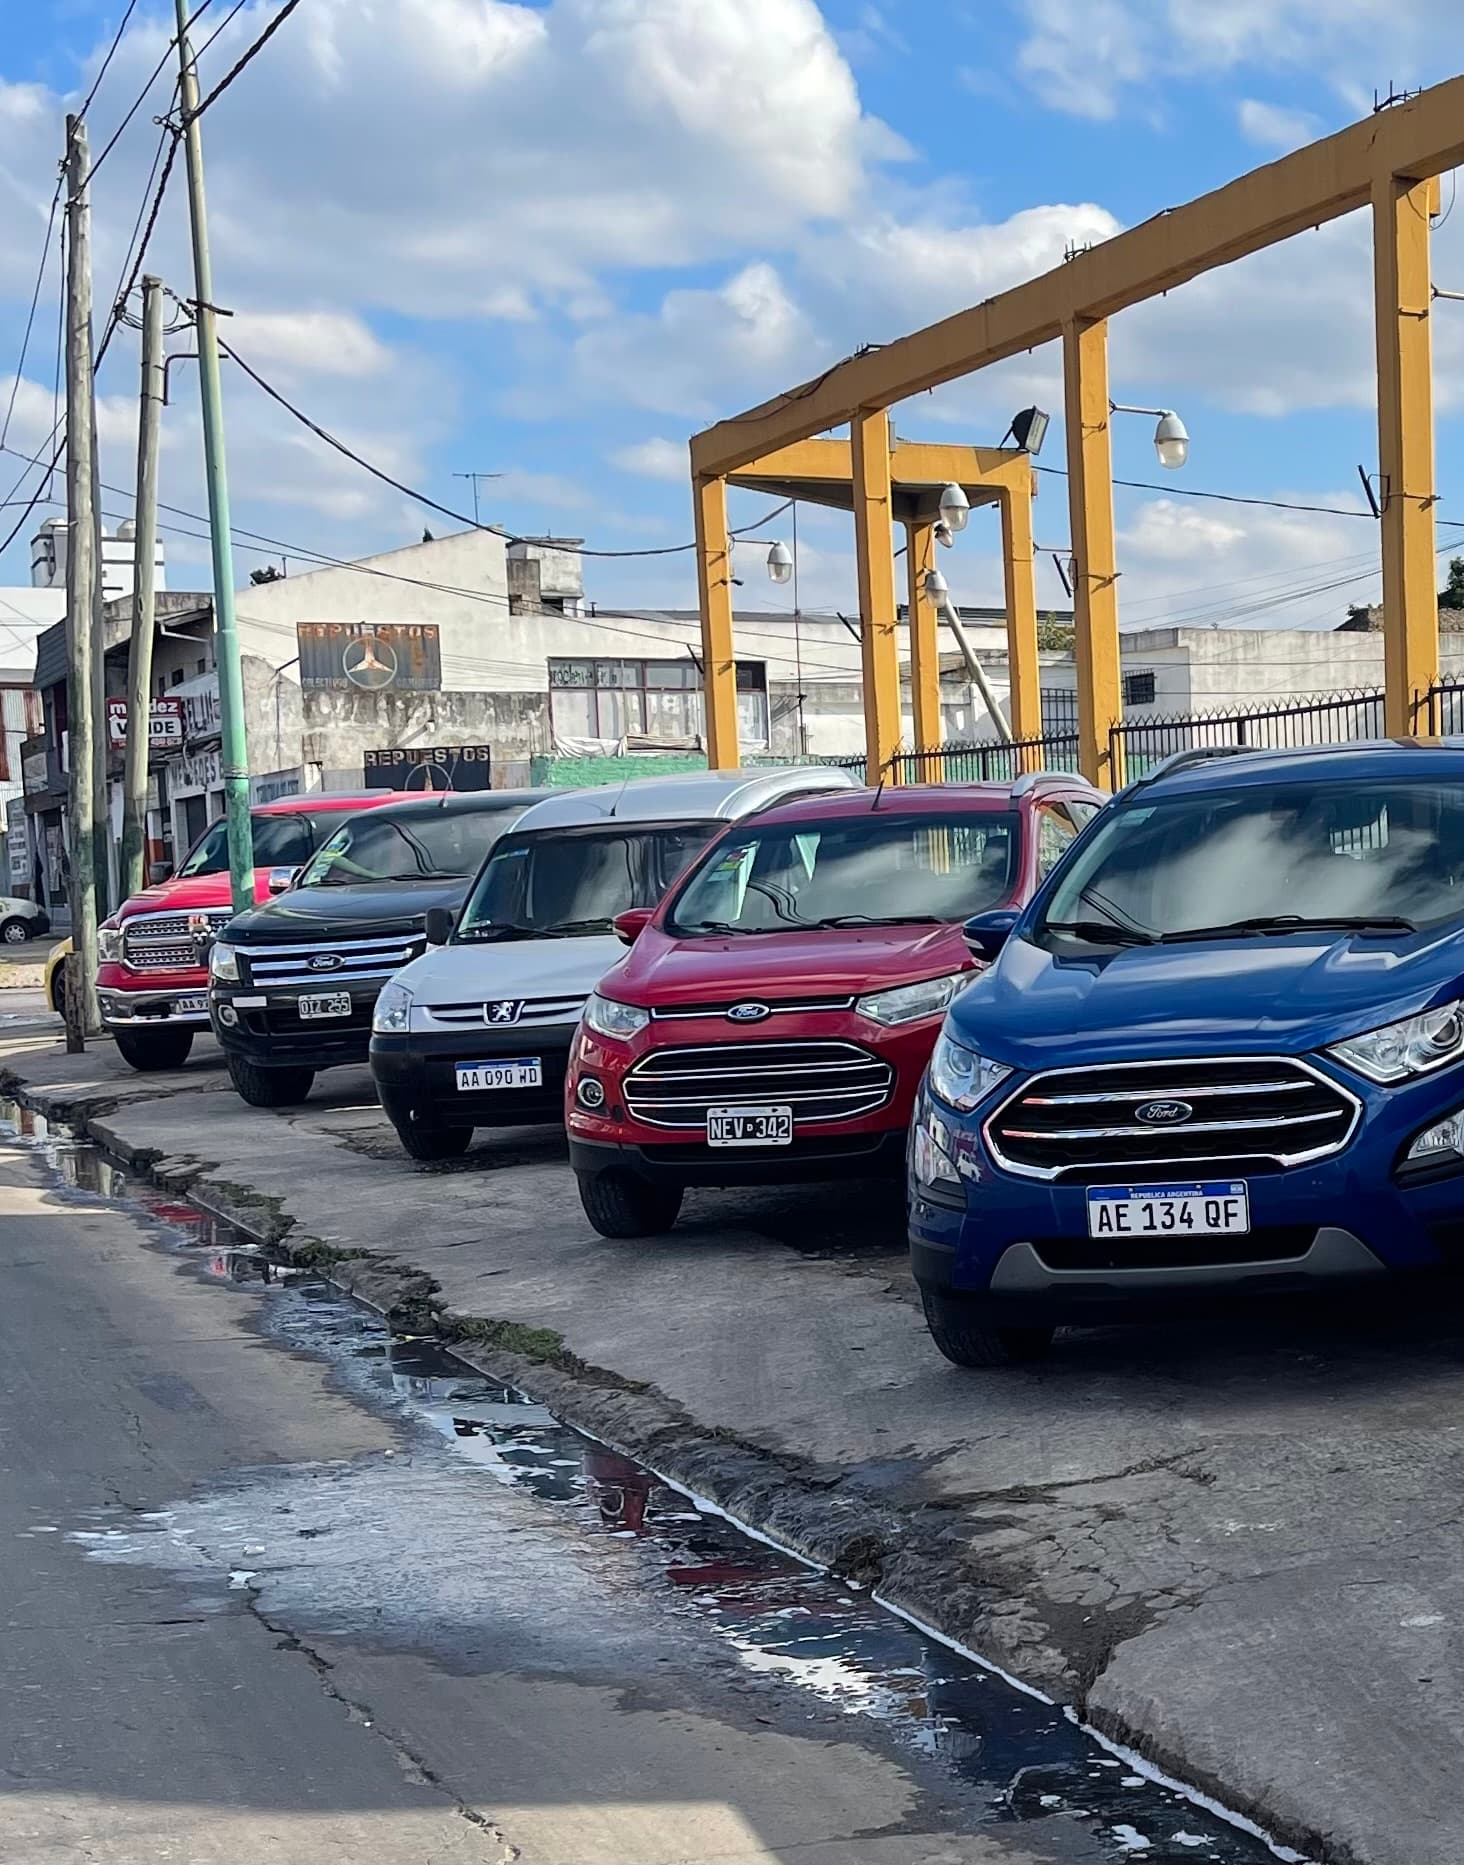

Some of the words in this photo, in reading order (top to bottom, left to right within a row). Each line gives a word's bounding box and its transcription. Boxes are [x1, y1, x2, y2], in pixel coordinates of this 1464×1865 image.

[117, 721, 174, 734] VDE
[365, 748, 489, 767] REPUESTOS
[312, 956, 335, 967] Ford
[328, 998, 348, 1012] 255
[735, 1004, 760, 1017] Ford
[461, 1072, 480, 1088] AA
[484, 1069, 513, 1086] 090
[1147, 1104, 1179, 1119] Ford
[710, 1117, 744, 1139] NEV
[755, 1115, 789, 1137] 342
[1130, 1191, 1166, 1199] REPUBLICA
[1167, 1189, 1204, 1197] ARGENTINA
[1098, 1203, 1132, 1232] AE
[1141, 1201, 1194, 1231] 134
[1204, 1199, 1239, 1228] QF
